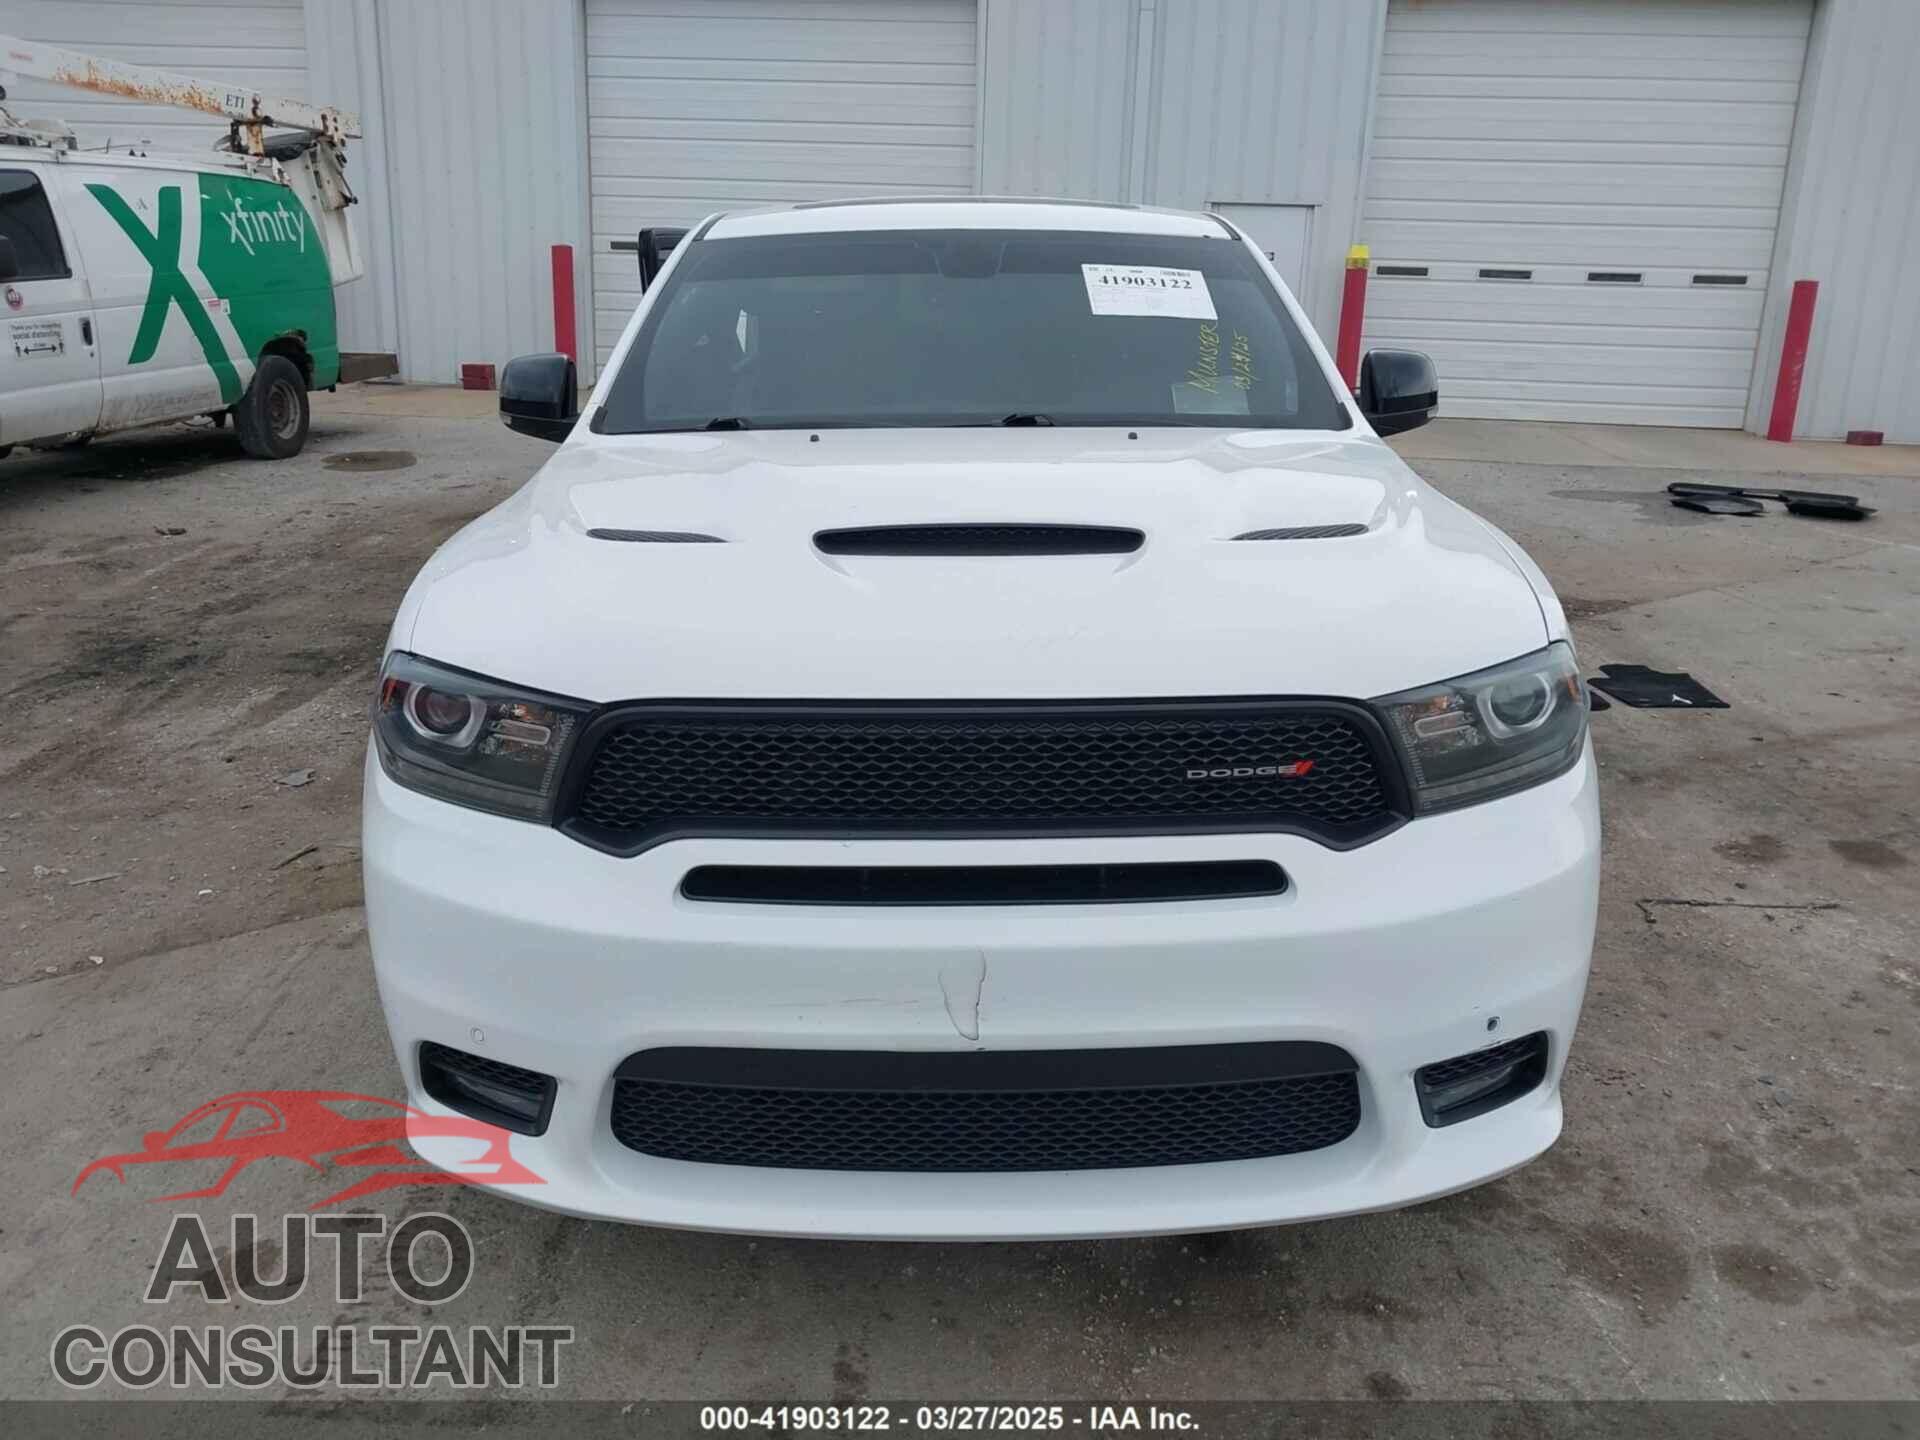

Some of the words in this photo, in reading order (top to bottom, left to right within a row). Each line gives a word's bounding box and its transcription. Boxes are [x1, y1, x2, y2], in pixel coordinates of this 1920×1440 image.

[219, 198, 305, 256] xfinity
[1099, 275, 1192, 289] 41903122
[1186, 764, 1297, 779] DODGE
